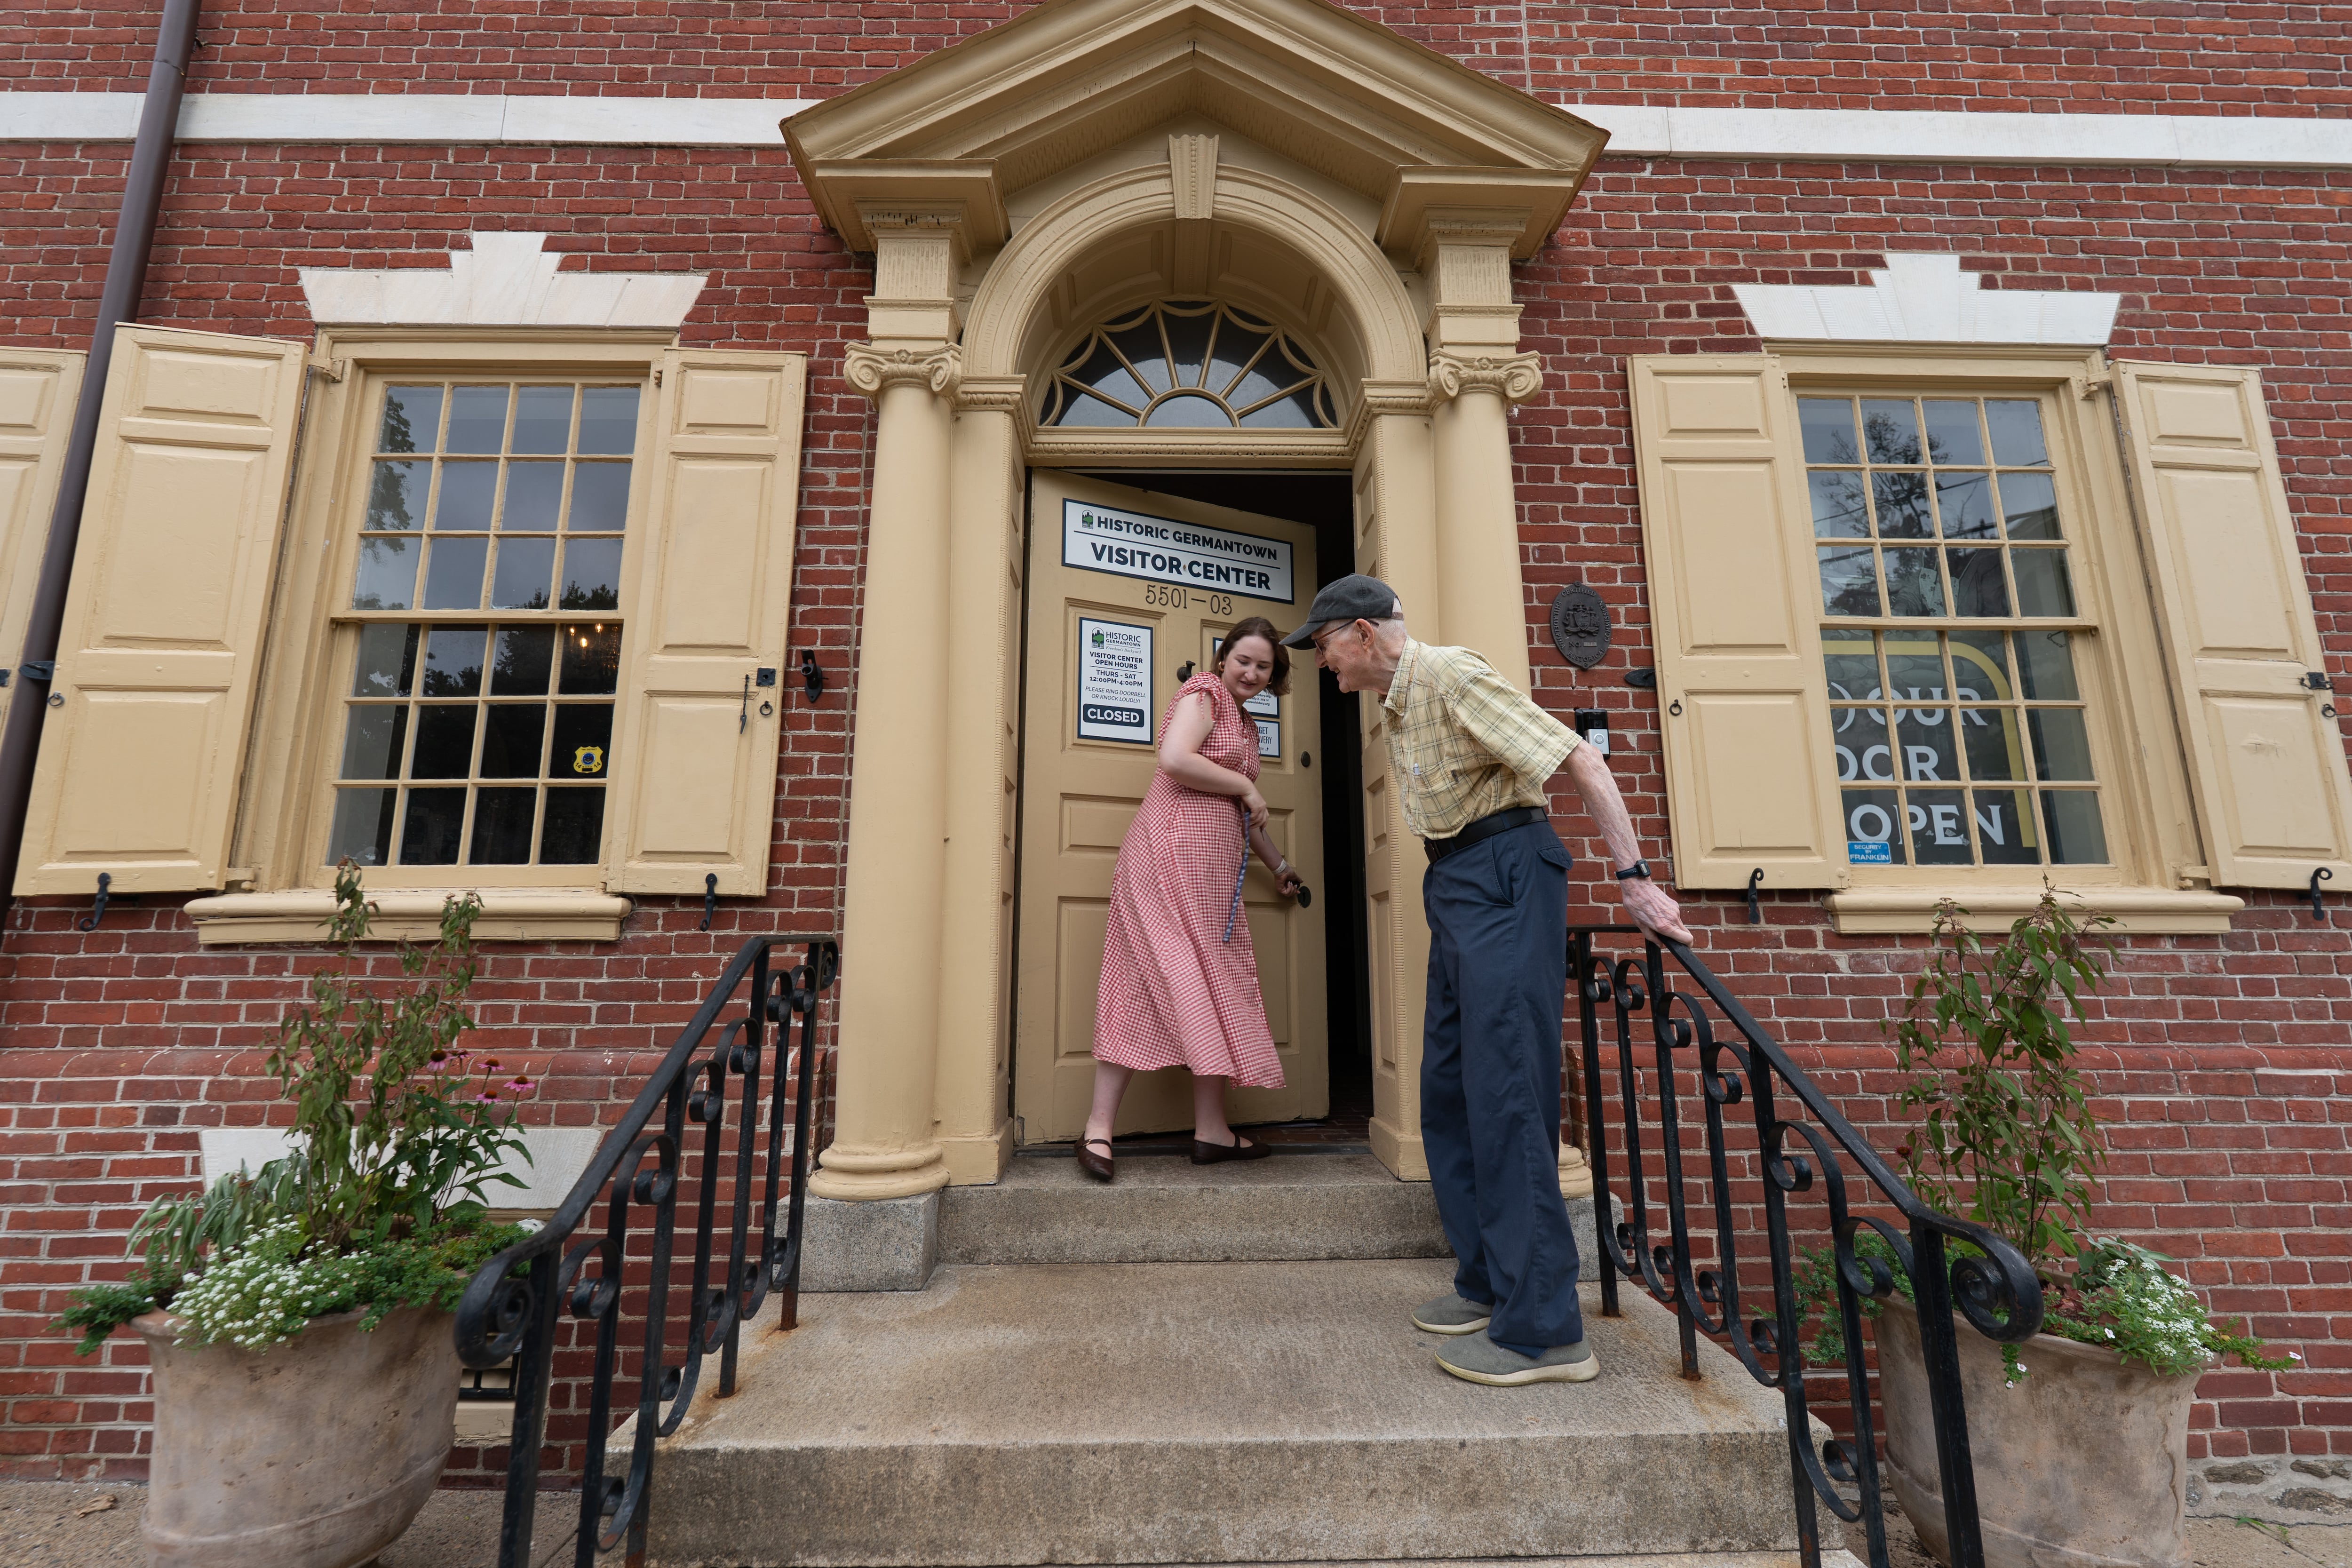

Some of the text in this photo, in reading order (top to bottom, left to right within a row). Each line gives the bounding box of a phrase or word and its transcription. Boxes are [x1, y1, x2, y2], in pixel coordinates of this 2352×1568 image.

[1097, 516, 1277, 560] HISTORIC GERMANTOWN
[1091, 542, 1271, 590] VISITOR CENTER
[1561, 588, 1596, 597] CERTIFIED
[1106, 631, 1141, 643] HISTORIC
[1553, 598, 1611, 662] PHILADELPHIA HISTORICAL COMMISSION
[1089, 677, 1143, 687] 12:00PM-4:00PM
[1087, 708, 1140, 723] CLOSED
[1867, 687, 1988, 726] OUR
[1851, 804, 2005, 845] OPEN
